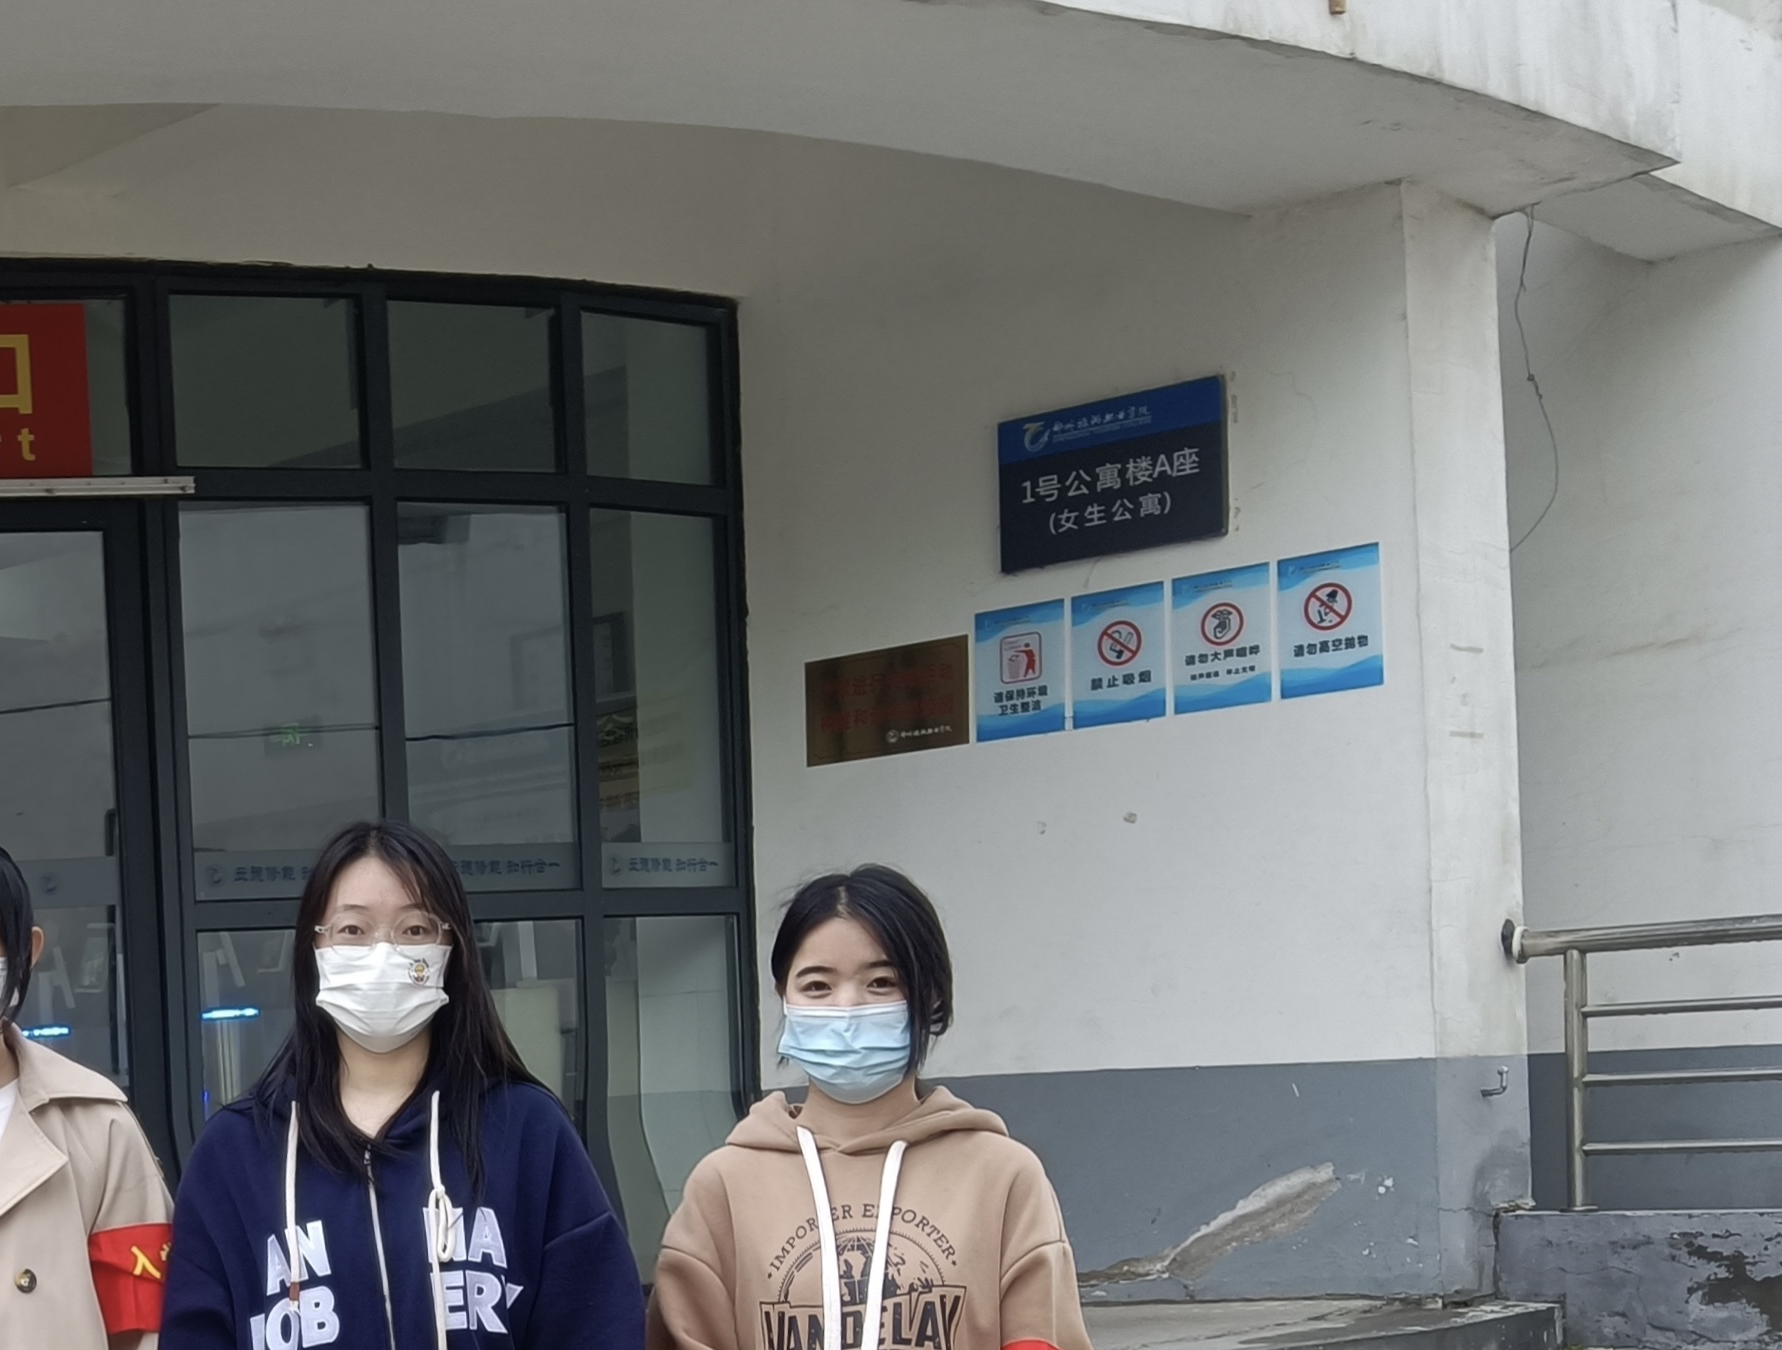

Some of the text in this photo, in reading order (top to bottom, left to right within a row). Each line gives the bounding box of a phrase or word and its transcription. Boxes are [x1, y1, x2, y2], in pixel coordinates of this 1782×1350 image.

[1021, 447, 1200, 503] 1号公寓楼A座
[1185, 644, 1261, 666] 请勿大声喧哗
[1293, 634, 1369, 658] 请勿高空抛物
[1090, 670, 1152, 691] 禁止吸烟
[994, 684, 1048, 703] 请保持环境
[998, 700, 1042, 717] 卫生整洁
[771, 1204, 956, 1272] IMPORER EPORTER
